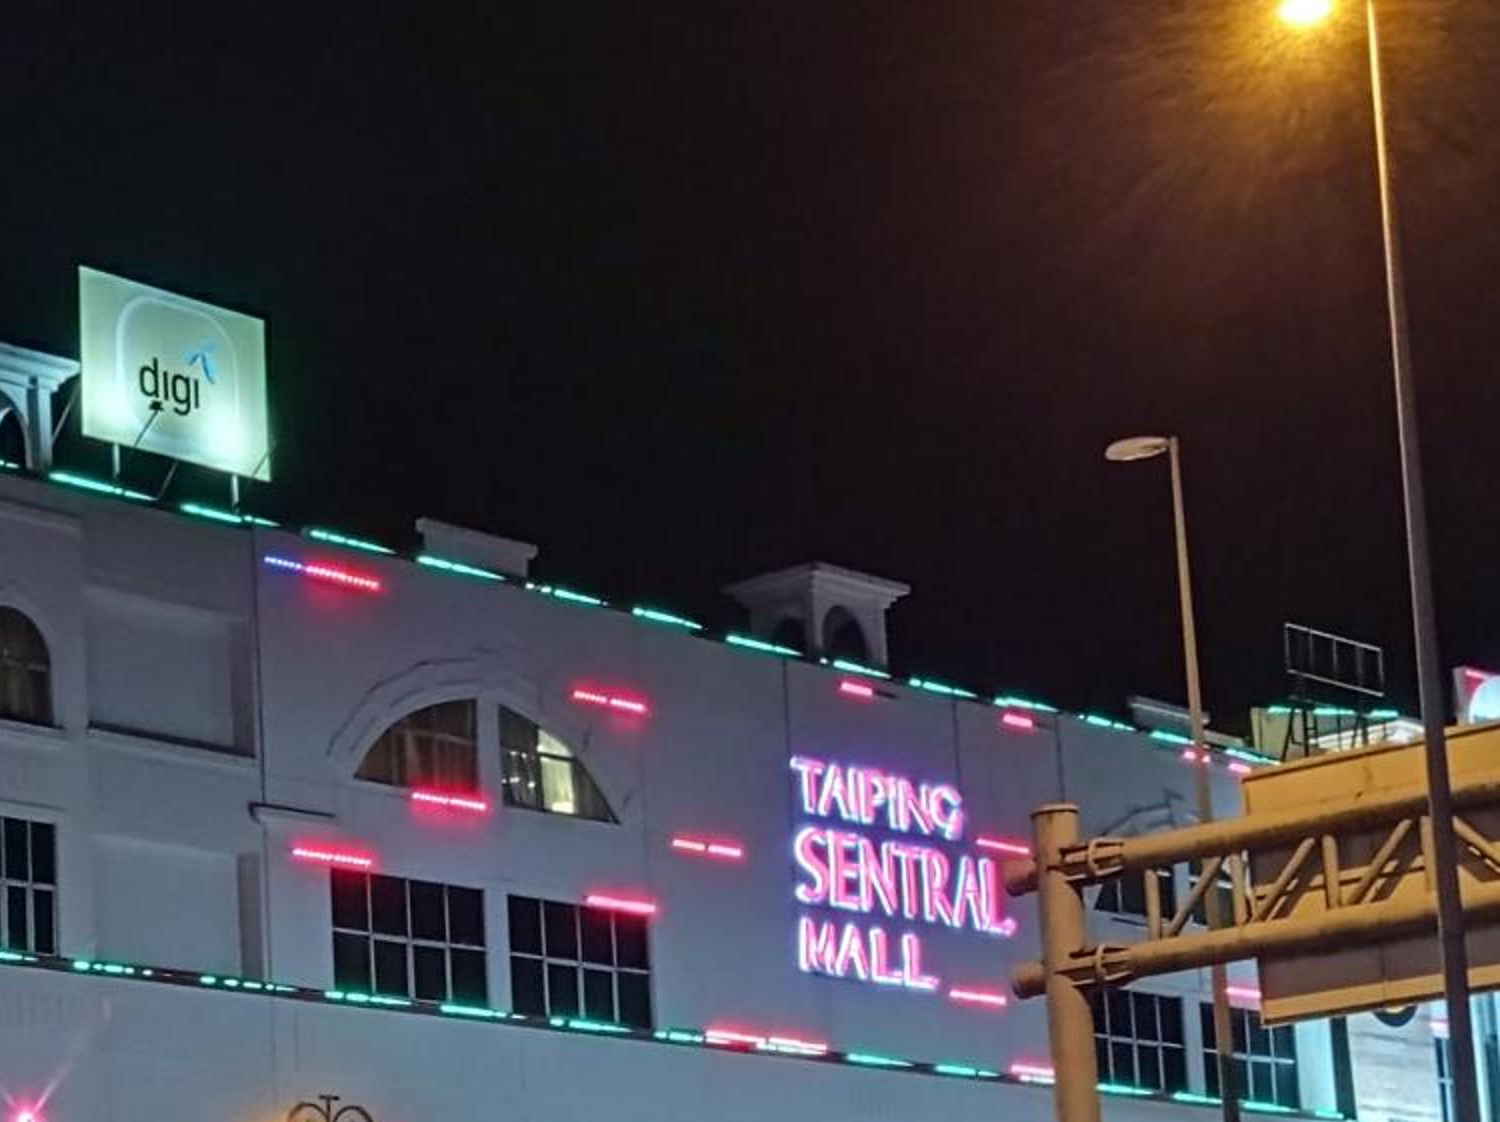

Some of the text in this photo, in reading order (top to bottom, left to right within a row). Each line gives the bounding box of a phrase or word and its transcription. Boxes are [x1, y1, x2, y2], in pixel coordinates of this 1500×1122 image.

[139, 356, 199, 416] digi
[789, 755, 964, 841] TAIPING
[794, 826, 1018, 937] SENTRAL
[798, 916, 940, 993] MALL
